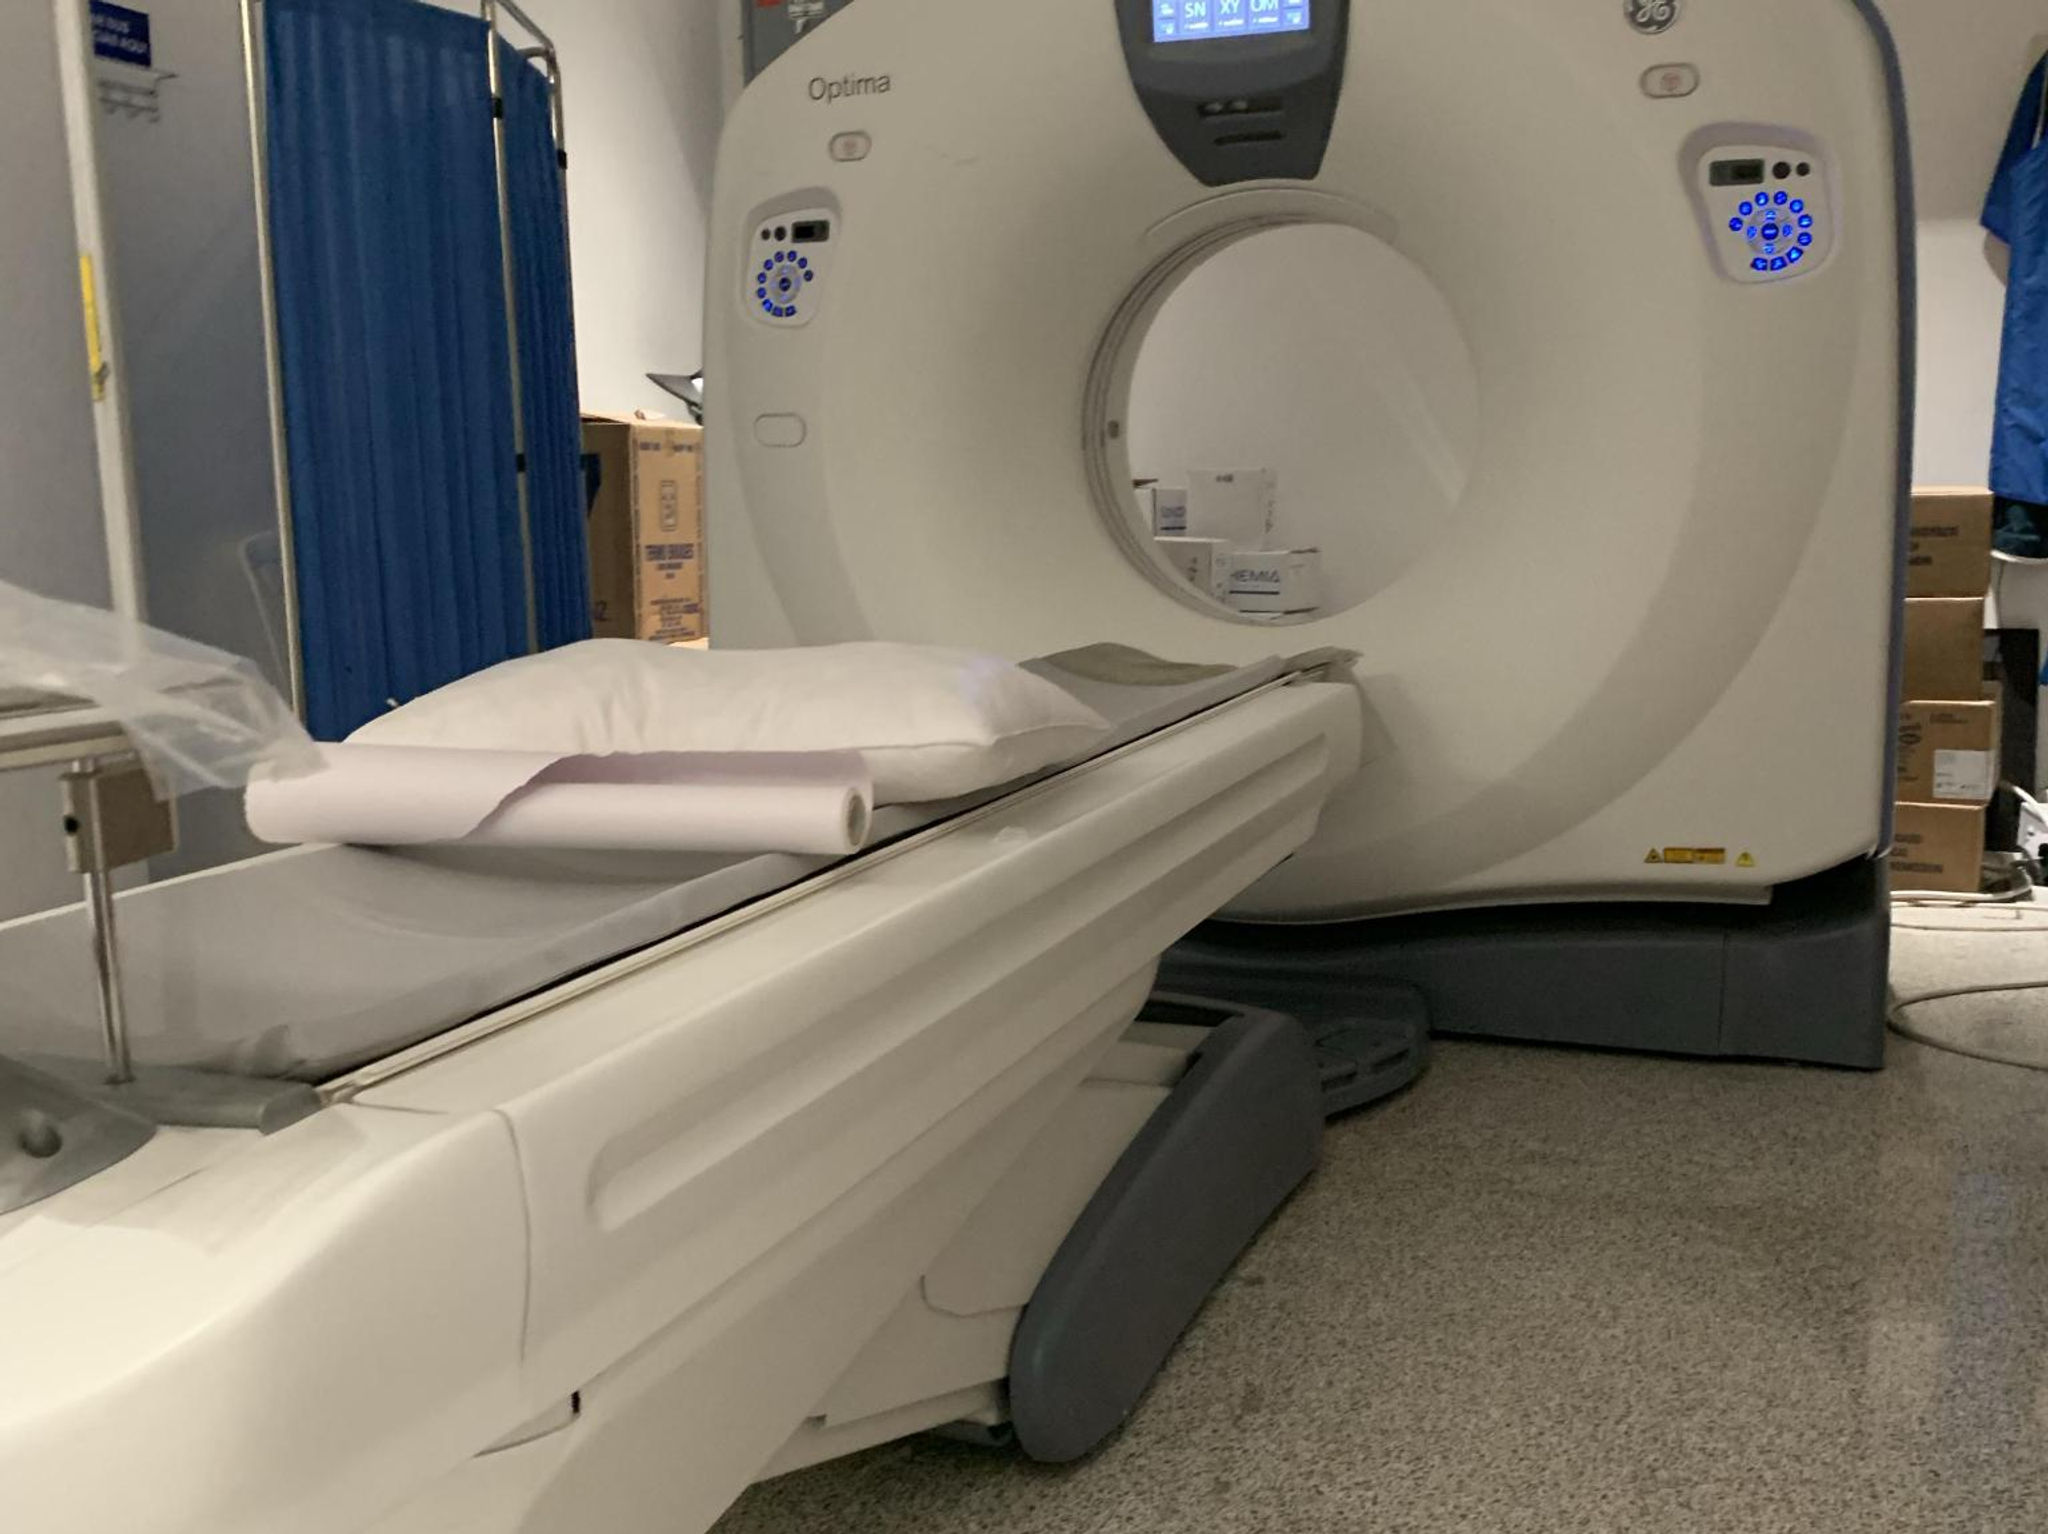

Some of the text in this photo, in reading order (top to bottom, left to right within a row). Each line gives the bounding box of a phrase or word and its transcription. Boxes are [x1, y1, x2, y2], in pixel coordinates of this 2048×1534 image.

[1184, 1, 1207, 18] SN
[1219, 0, 1240, 14] XY
[808, 75, 892, 103] Optima
